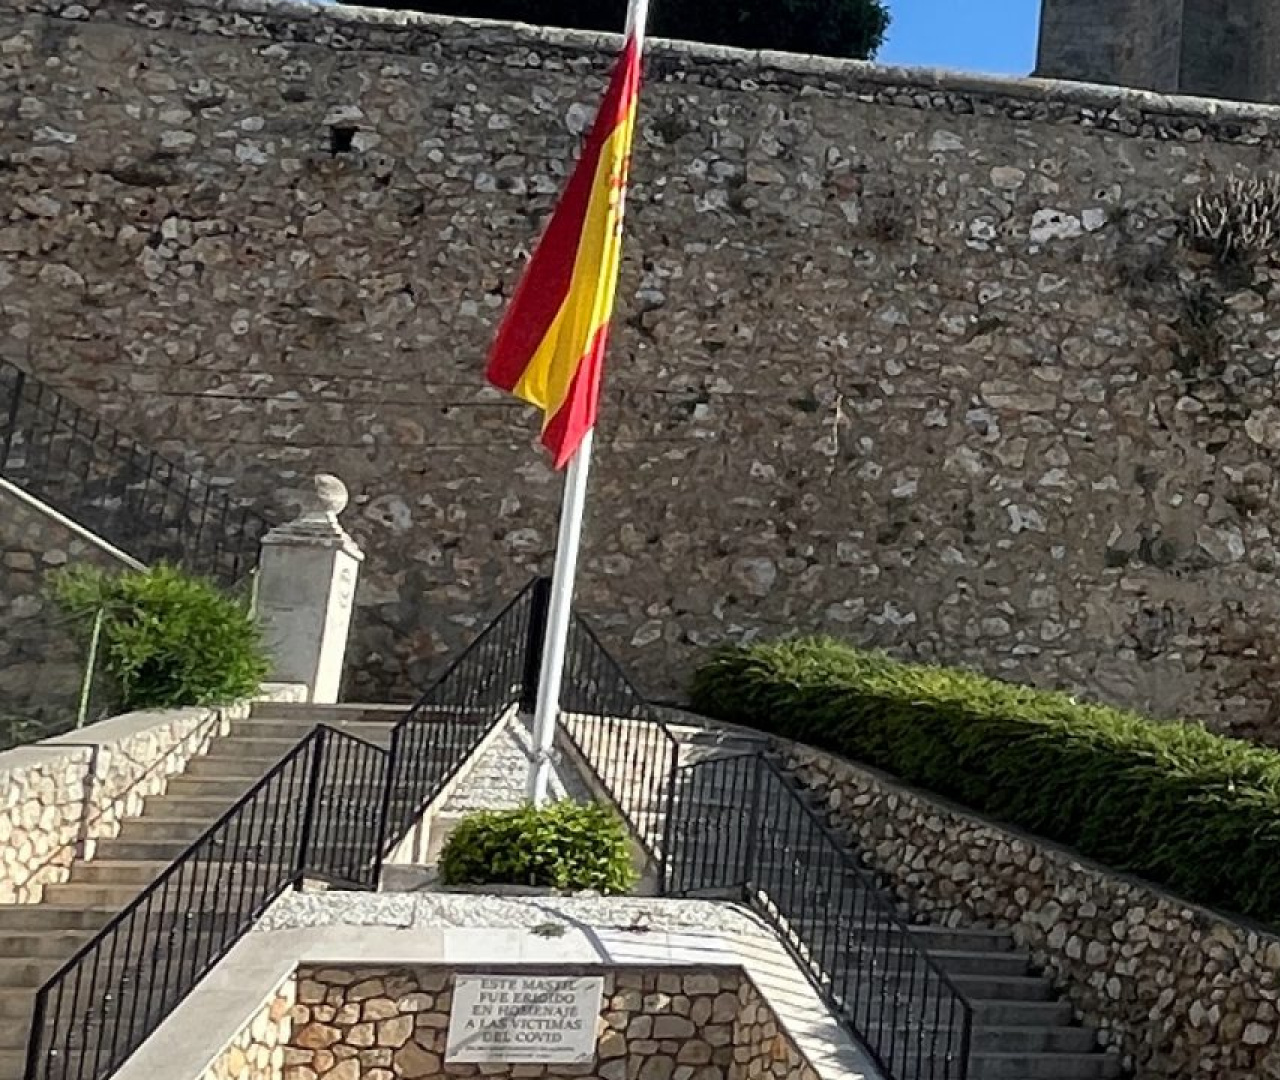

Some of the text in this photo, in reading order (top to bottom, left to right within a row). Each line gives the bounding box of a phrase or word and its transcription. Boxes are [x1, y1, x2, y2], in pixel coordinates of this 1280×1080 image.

[481, 979, 517, 989] ESTE
[480, 992, 509, 1003] FUE
[473, 1004, 577, 1017] EN HOMENAJE
[465, 1018, 475, 1029] A
[480, 1018, 508, 1030] LAS
[482, 1031, 563, 1043] DEL COVID
